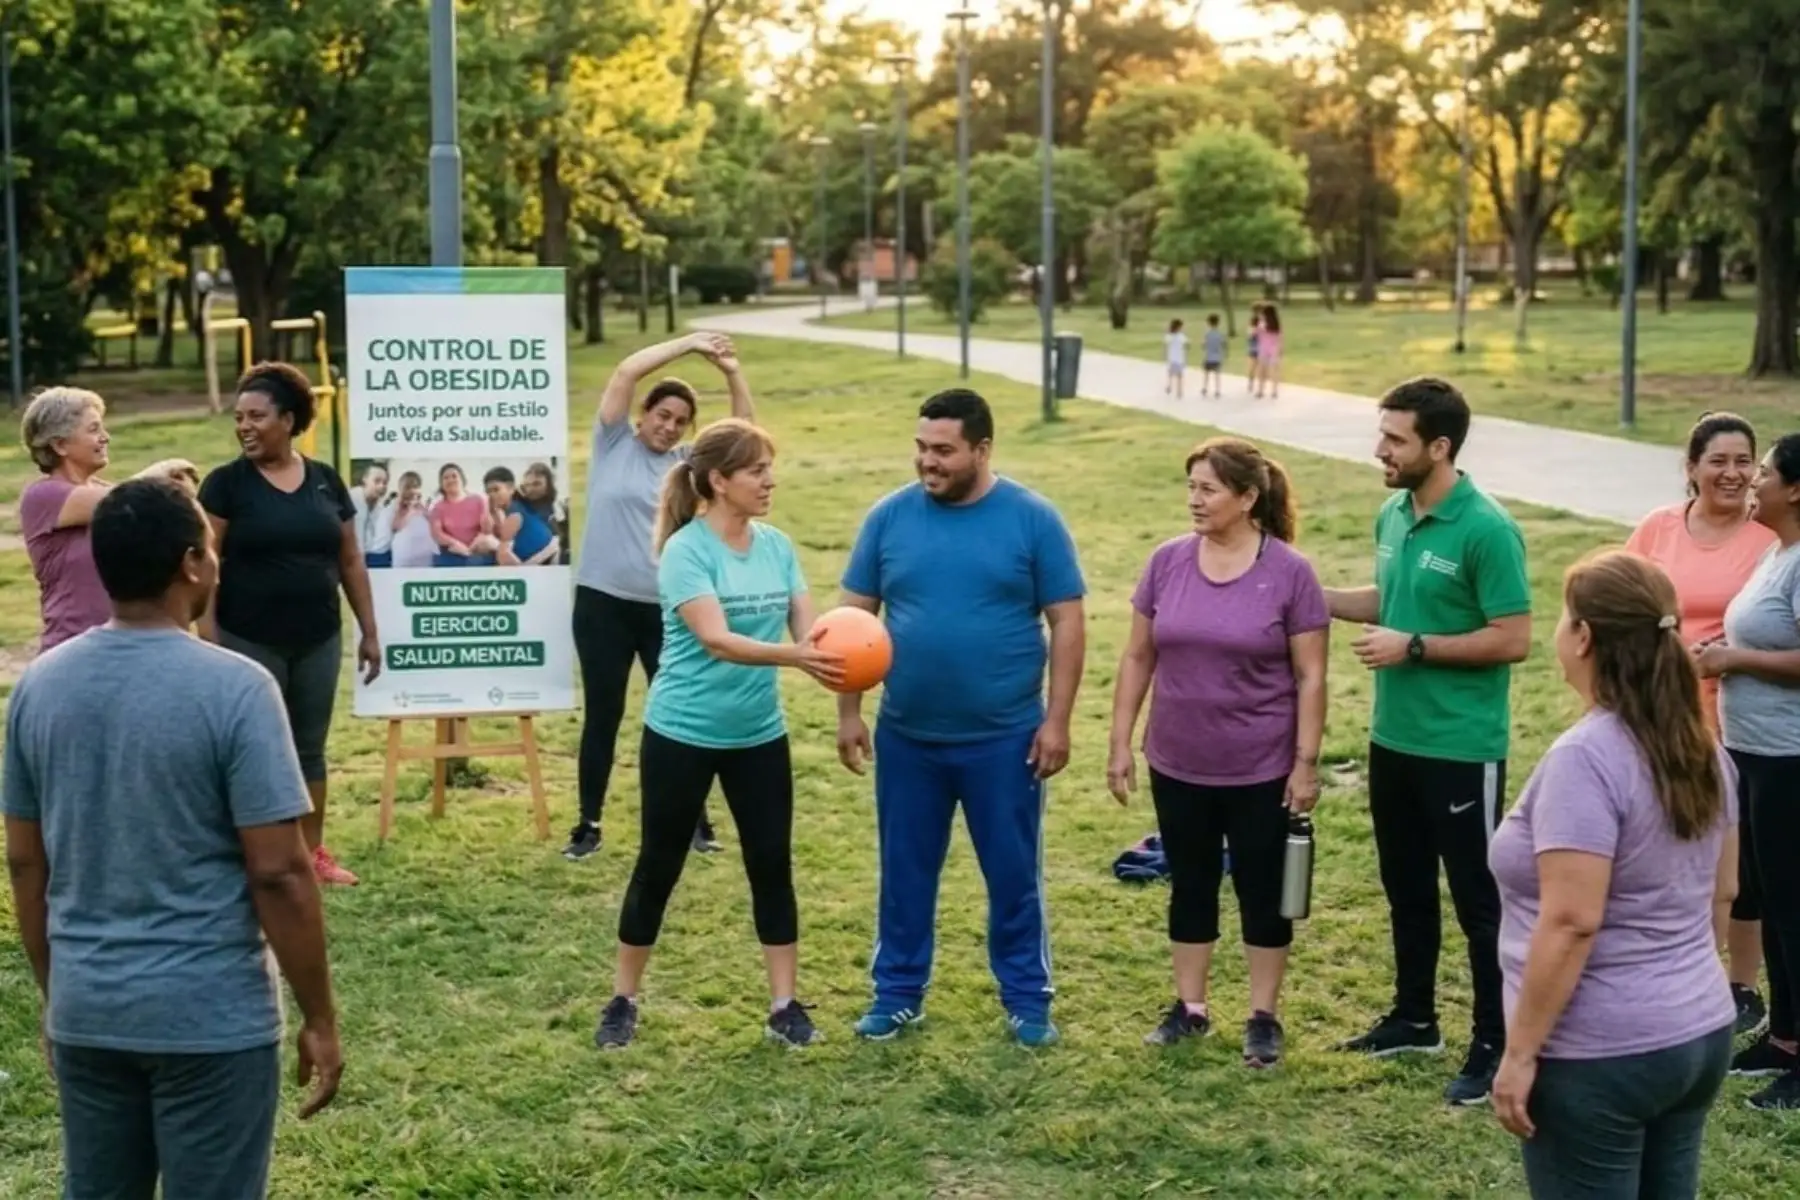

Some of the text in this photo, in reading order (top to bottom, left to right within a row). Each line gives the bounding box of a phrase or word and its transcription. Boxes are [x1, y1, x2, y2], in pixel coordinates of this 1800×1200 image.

[367, 339, 546, 361] CONTROL DE
[365, 369, 550, 391] LA OBESIDAD
[368, 402, 549, 422] Juntos por un Estilo
[374, 425, 544, 442] de Vida Saludable.
[410, 581, 519, 602] NUTRICIÓN,
[420, 616, 509, 635] EJERCICIO
[393, 646, 538, 666] SALUD MENTAL
